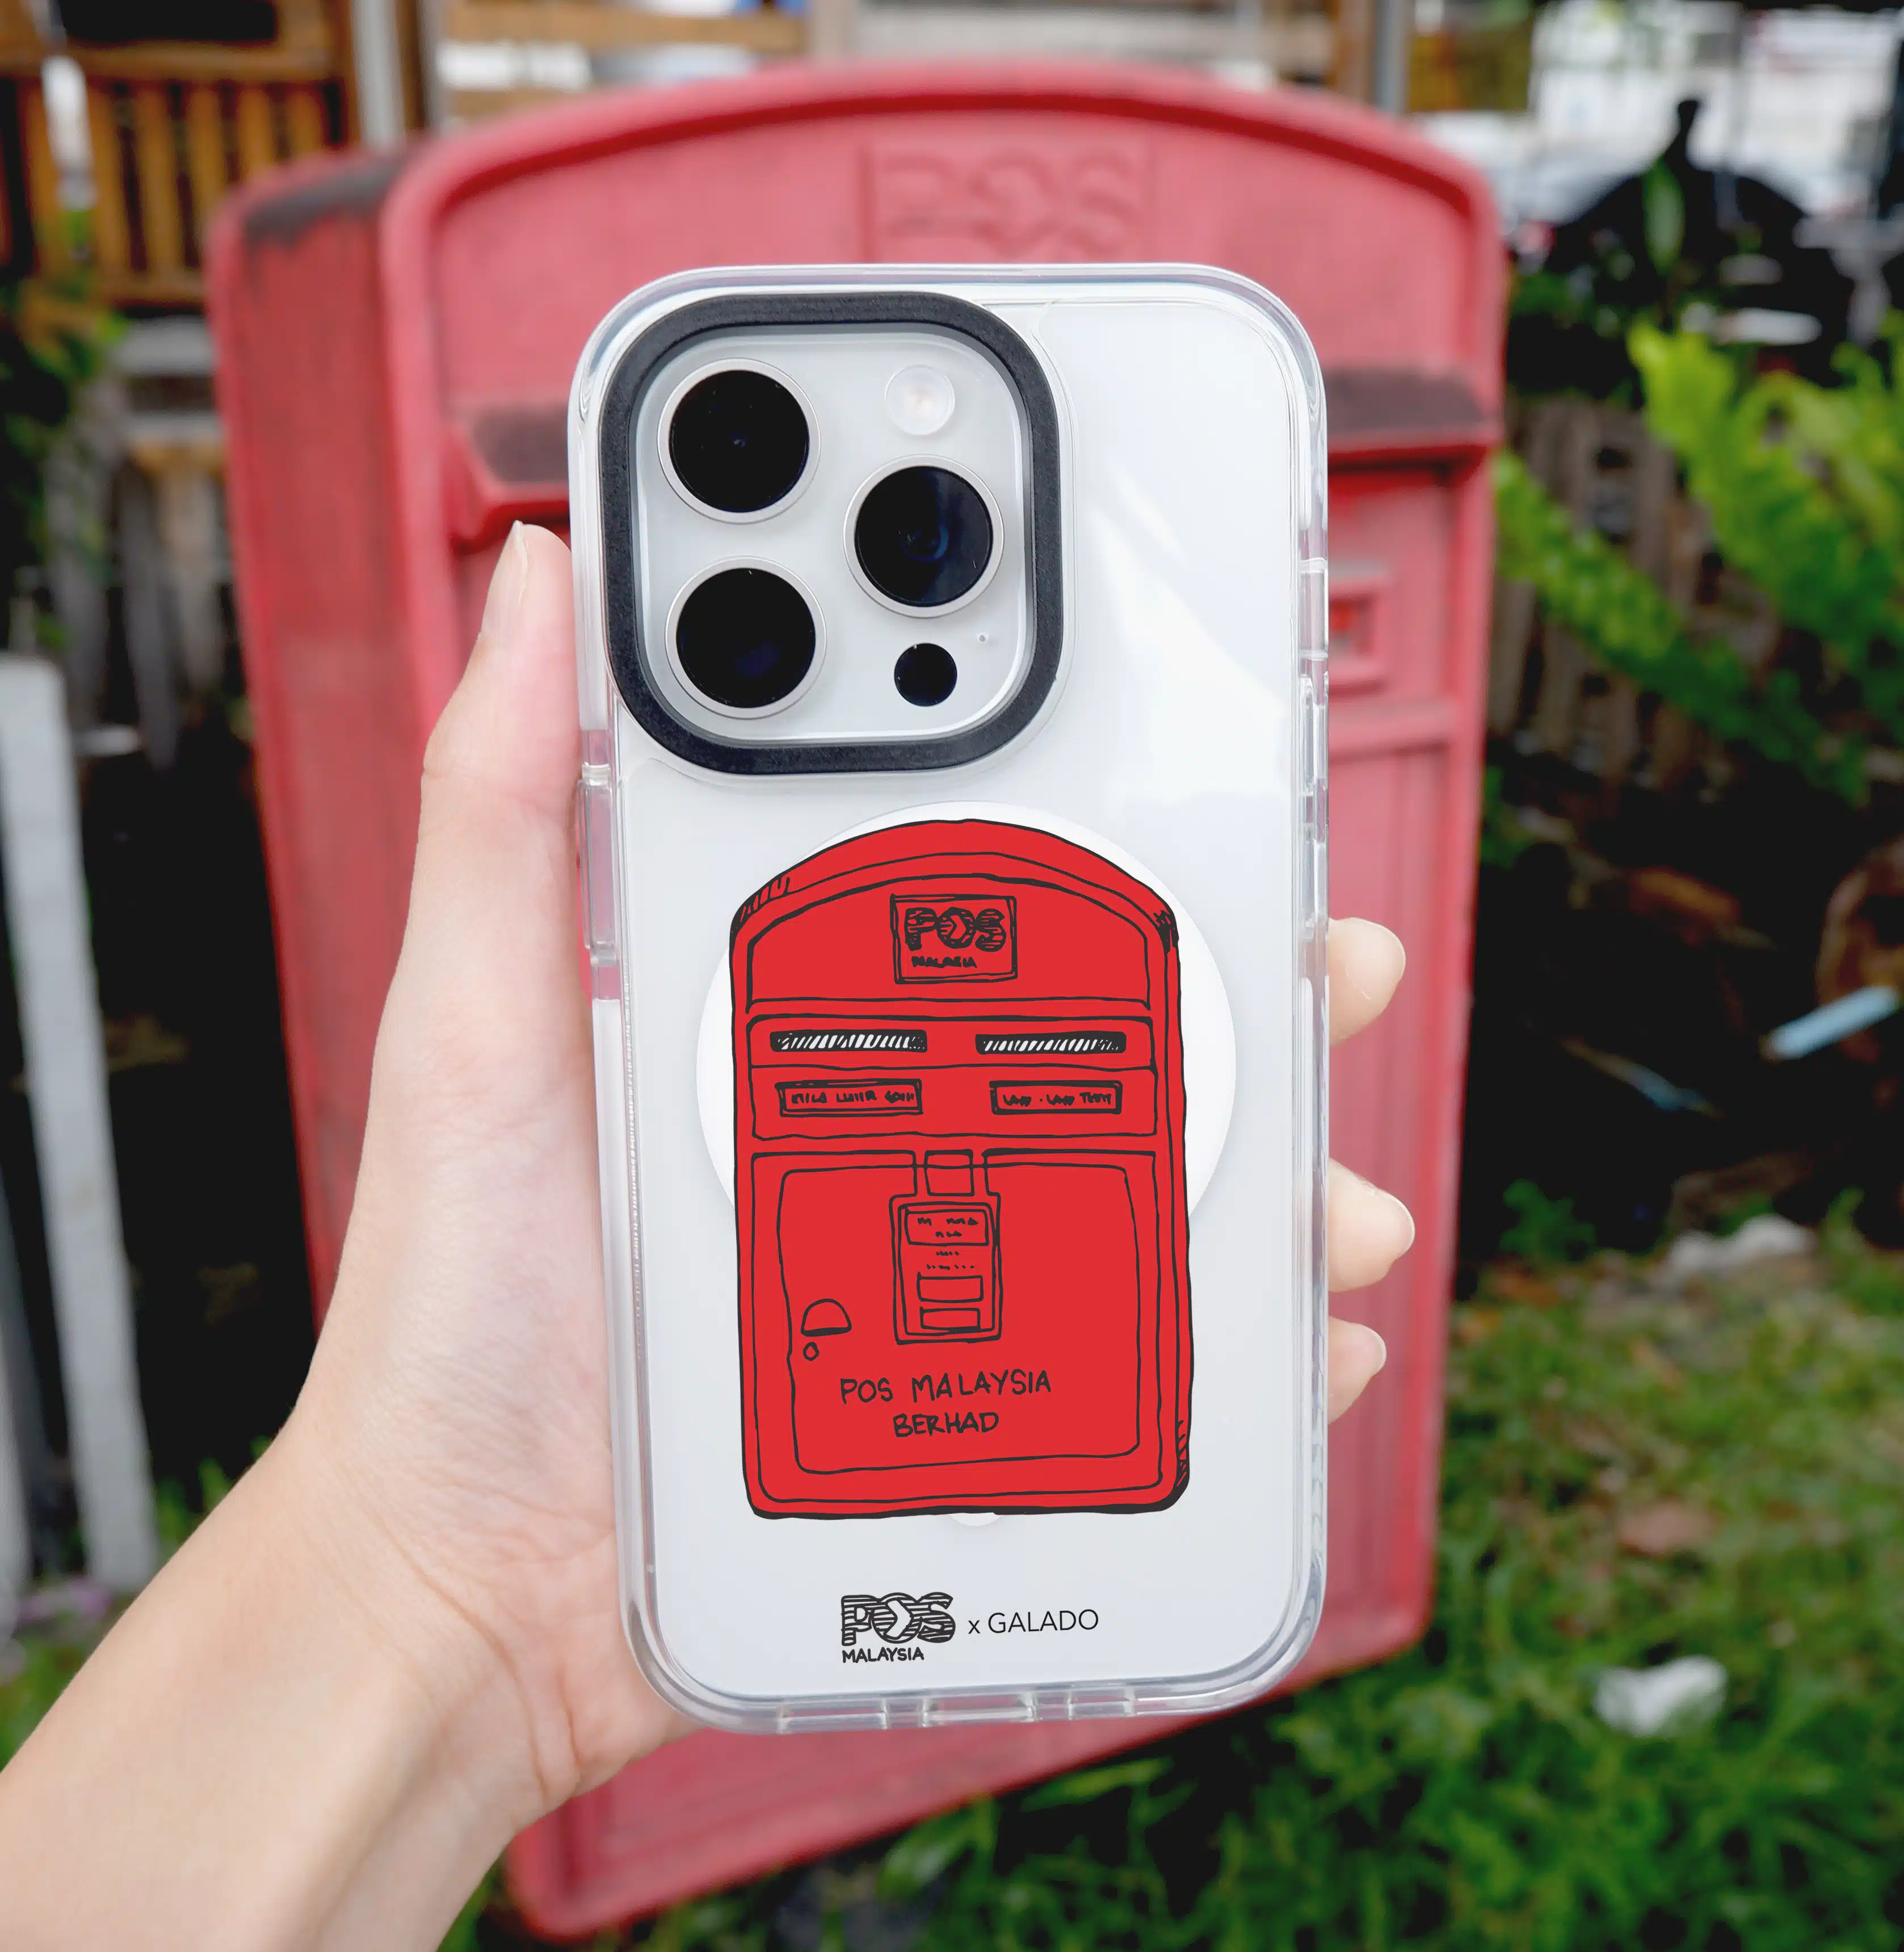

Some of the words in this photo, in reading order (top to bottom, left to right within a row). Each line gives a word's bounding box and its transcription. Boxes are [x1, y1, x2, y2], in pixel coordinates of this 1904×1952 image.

[904, 906, 1007, 952] POS
[840, 1378, 893, 1404] POS
[911, 1369, 1051, 1403] MALAYSIA
[893, 1412, 999, 1438] BERHAD
[840, 1592, 956, 1646] POS
[988, 1609, 1099, 1634] GALADO
[842, 1646, 924, 1664] MALAYSIA
